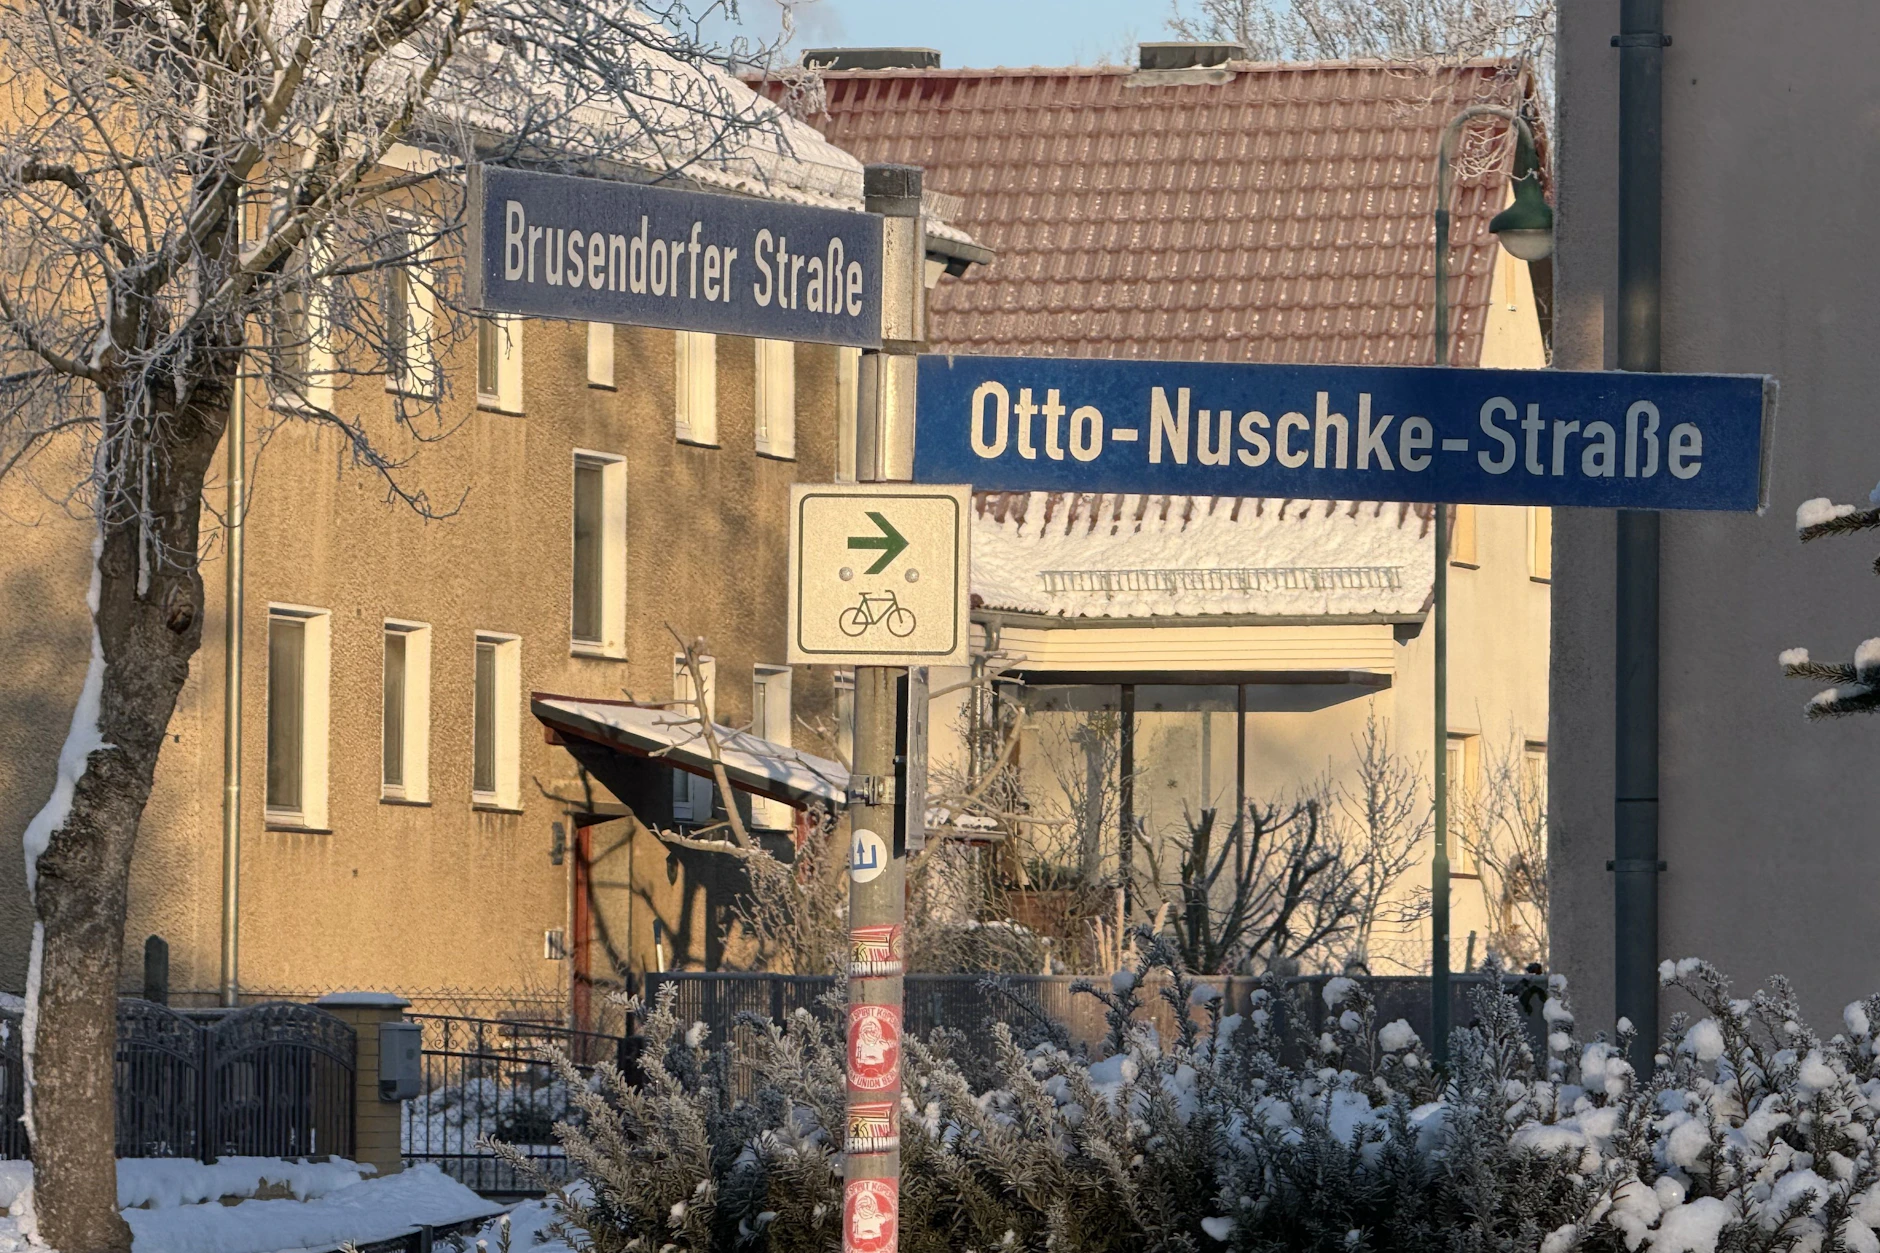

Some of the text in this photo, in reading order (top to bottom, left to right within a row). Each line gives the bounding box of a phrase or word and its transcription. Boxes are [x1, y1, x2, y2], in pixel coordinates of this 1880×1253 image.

[504, 200, 863, 317] Brusendorfer Straße
[970, 380, 1703, 480] Otto-Nuschke-Straße
[857, 1076, 881, 1088] UNION
